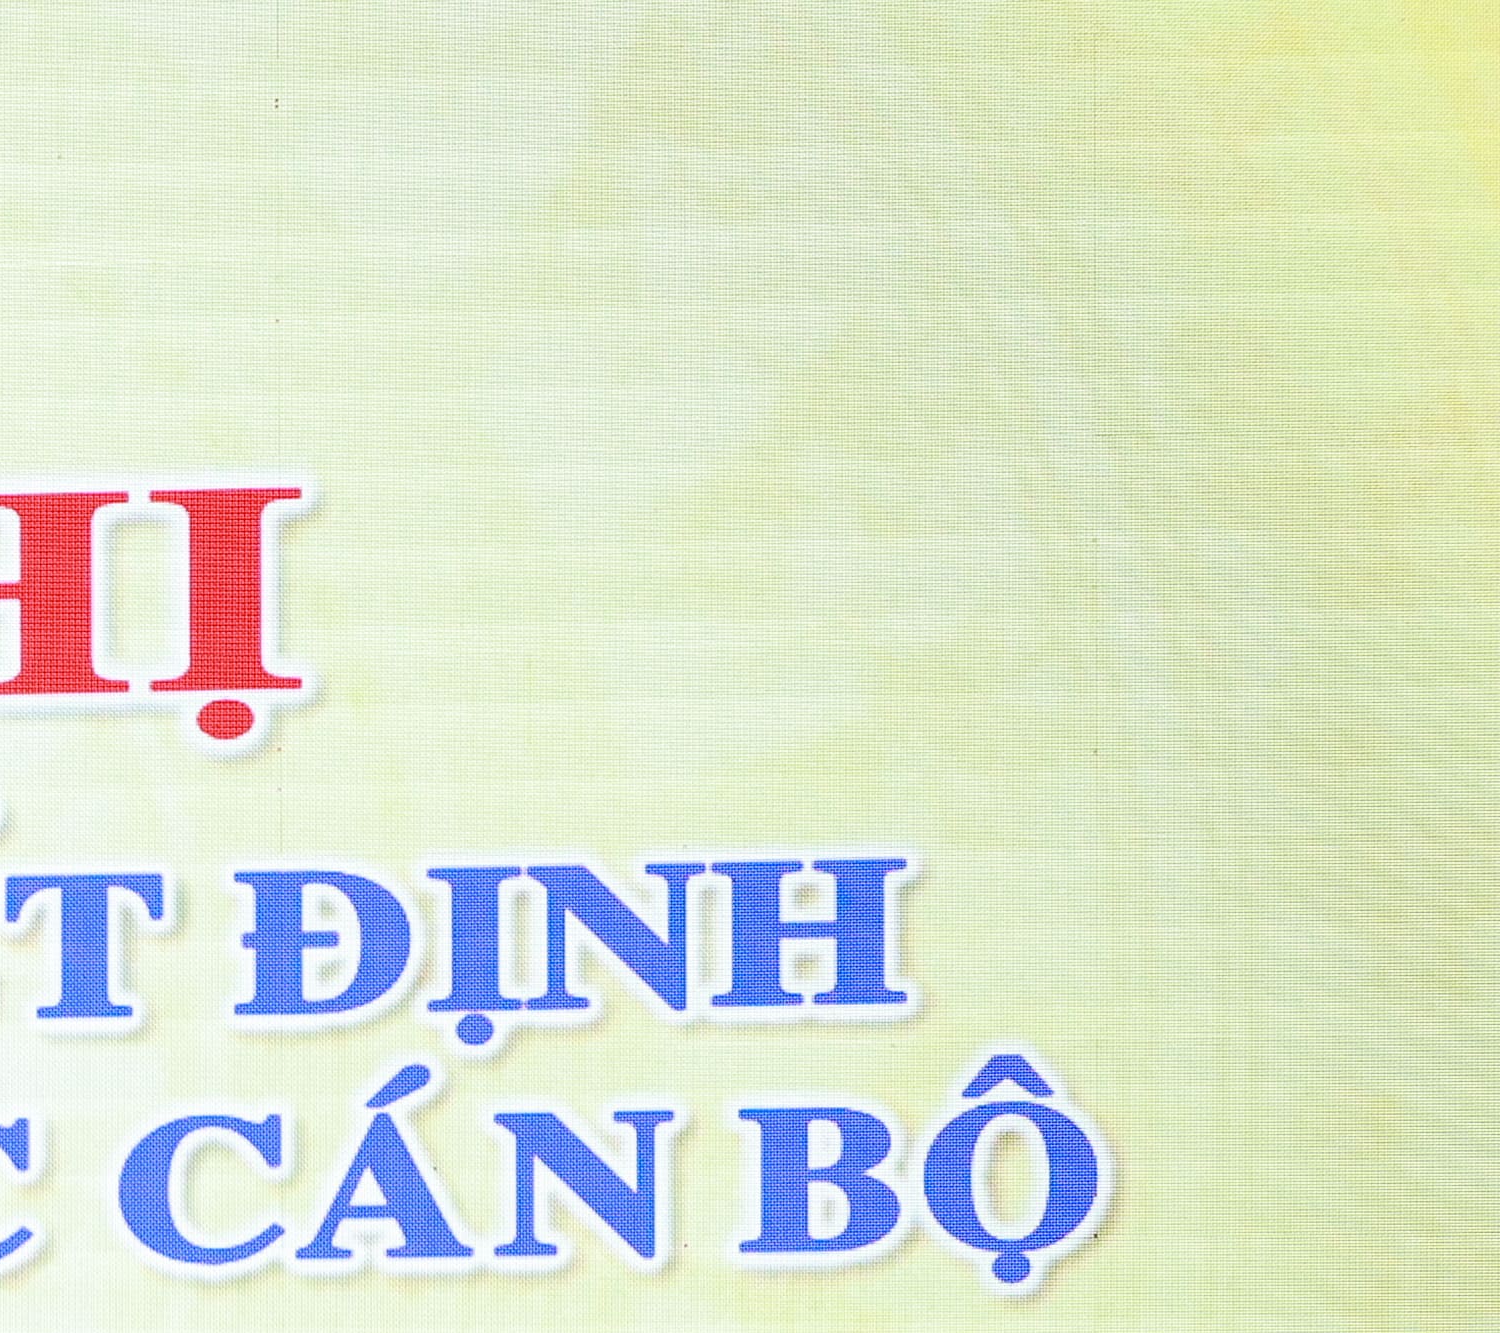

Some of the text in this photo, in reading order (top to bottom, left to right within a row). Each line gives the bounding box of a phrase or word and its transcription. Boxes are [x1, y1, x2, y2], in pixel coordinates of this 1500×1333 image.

[234, 858, 908, 1046] ĐỊNH
[117, 1063, 676, 1264] CÁN
[737, 1053, 1100, 1284] BỘ
